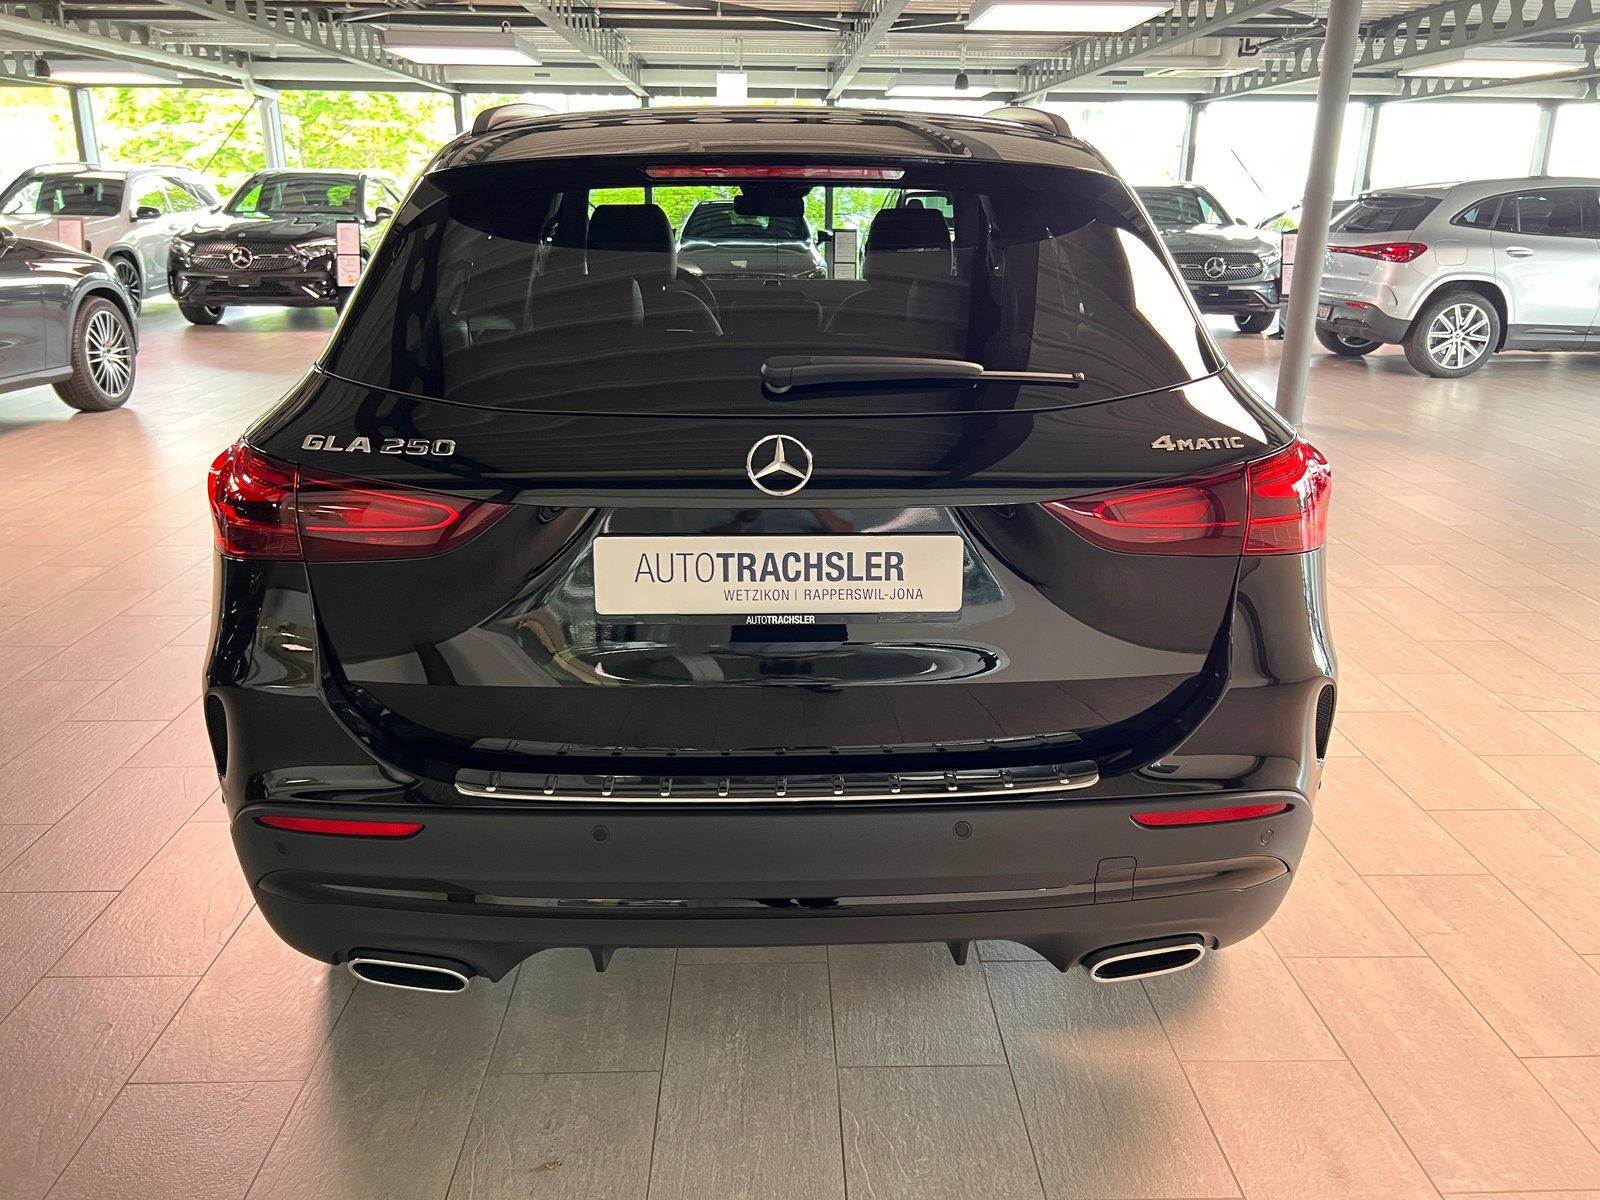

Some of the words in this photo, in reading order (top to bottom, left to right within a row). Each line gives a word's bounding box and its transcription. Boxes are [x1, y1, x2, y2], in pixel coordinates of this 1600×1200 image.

[301, 434, 371, 454] GLA
[379, 438, 456, 456] 250
[1151, 434, 1245, 452] 4MATIC
[634, 551, 905, 583] AUTOTRACHSLER
[723, 588, 789, 601] WETZIKON
[804, 587, 924, 601] RAPPERSWIL-JONA
[745, 615, 816, 625] AUTOTRACHSLER
